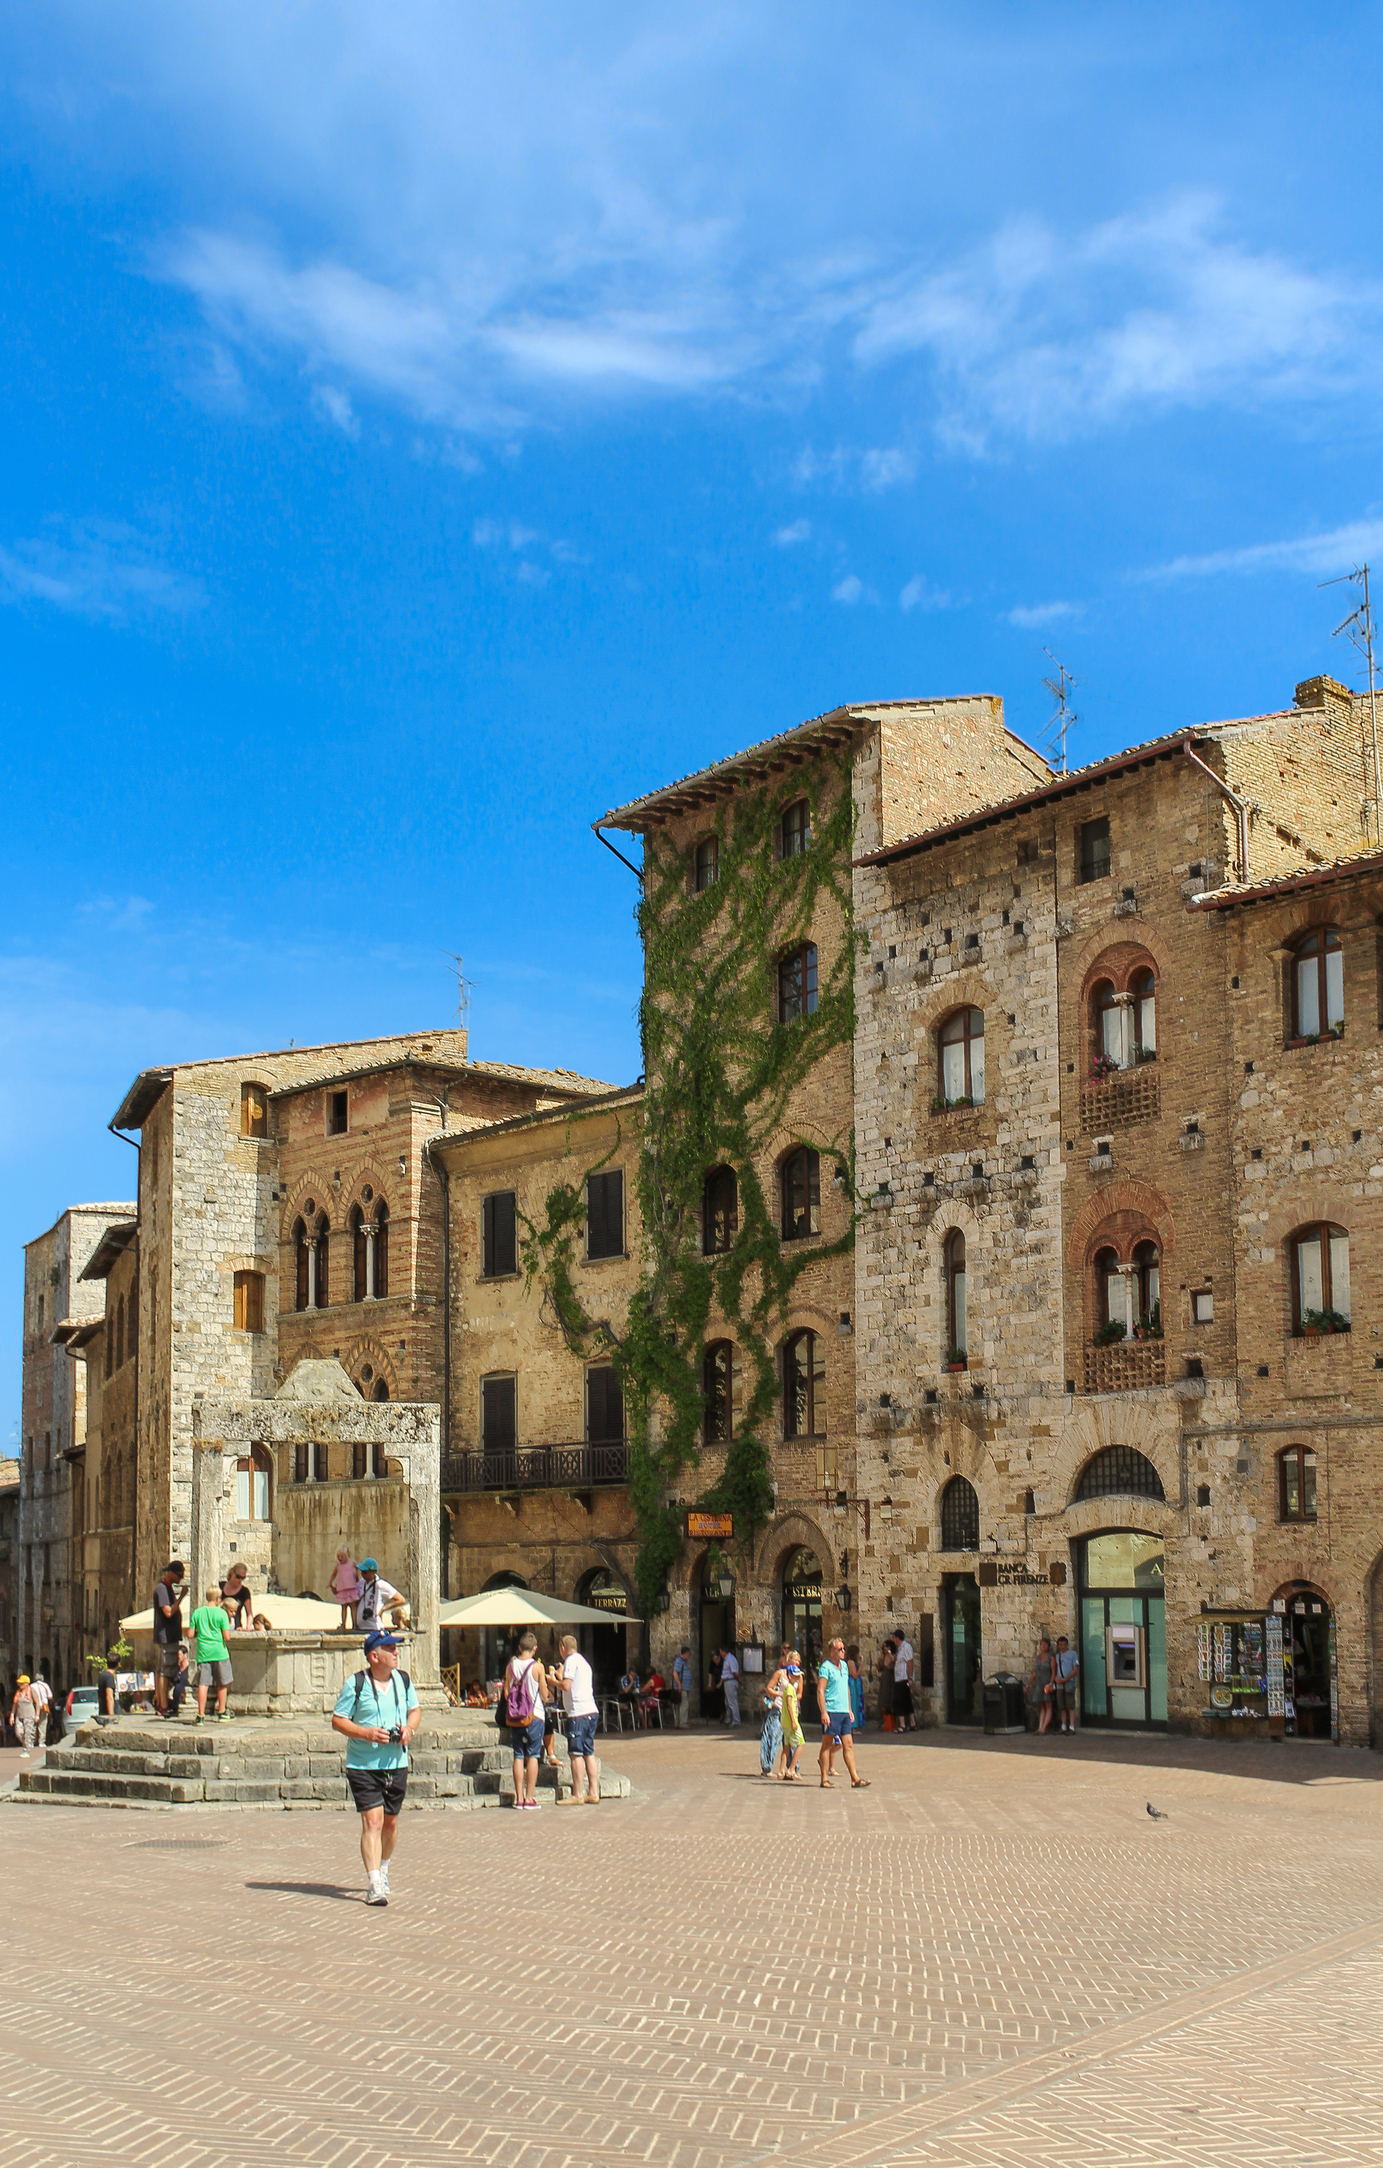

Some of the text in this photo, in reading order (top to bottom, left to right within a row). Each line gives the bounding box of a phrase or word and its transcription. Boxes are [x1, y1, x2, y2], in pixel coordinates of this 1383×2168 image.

[688, 1513, 698, 1521] LA
[698, 1521, 722, 1529] HOTEL
[998, 1563, 1030, 1573] BANCA
[998, 1574, 1049, 1584] CR FIRENZE
